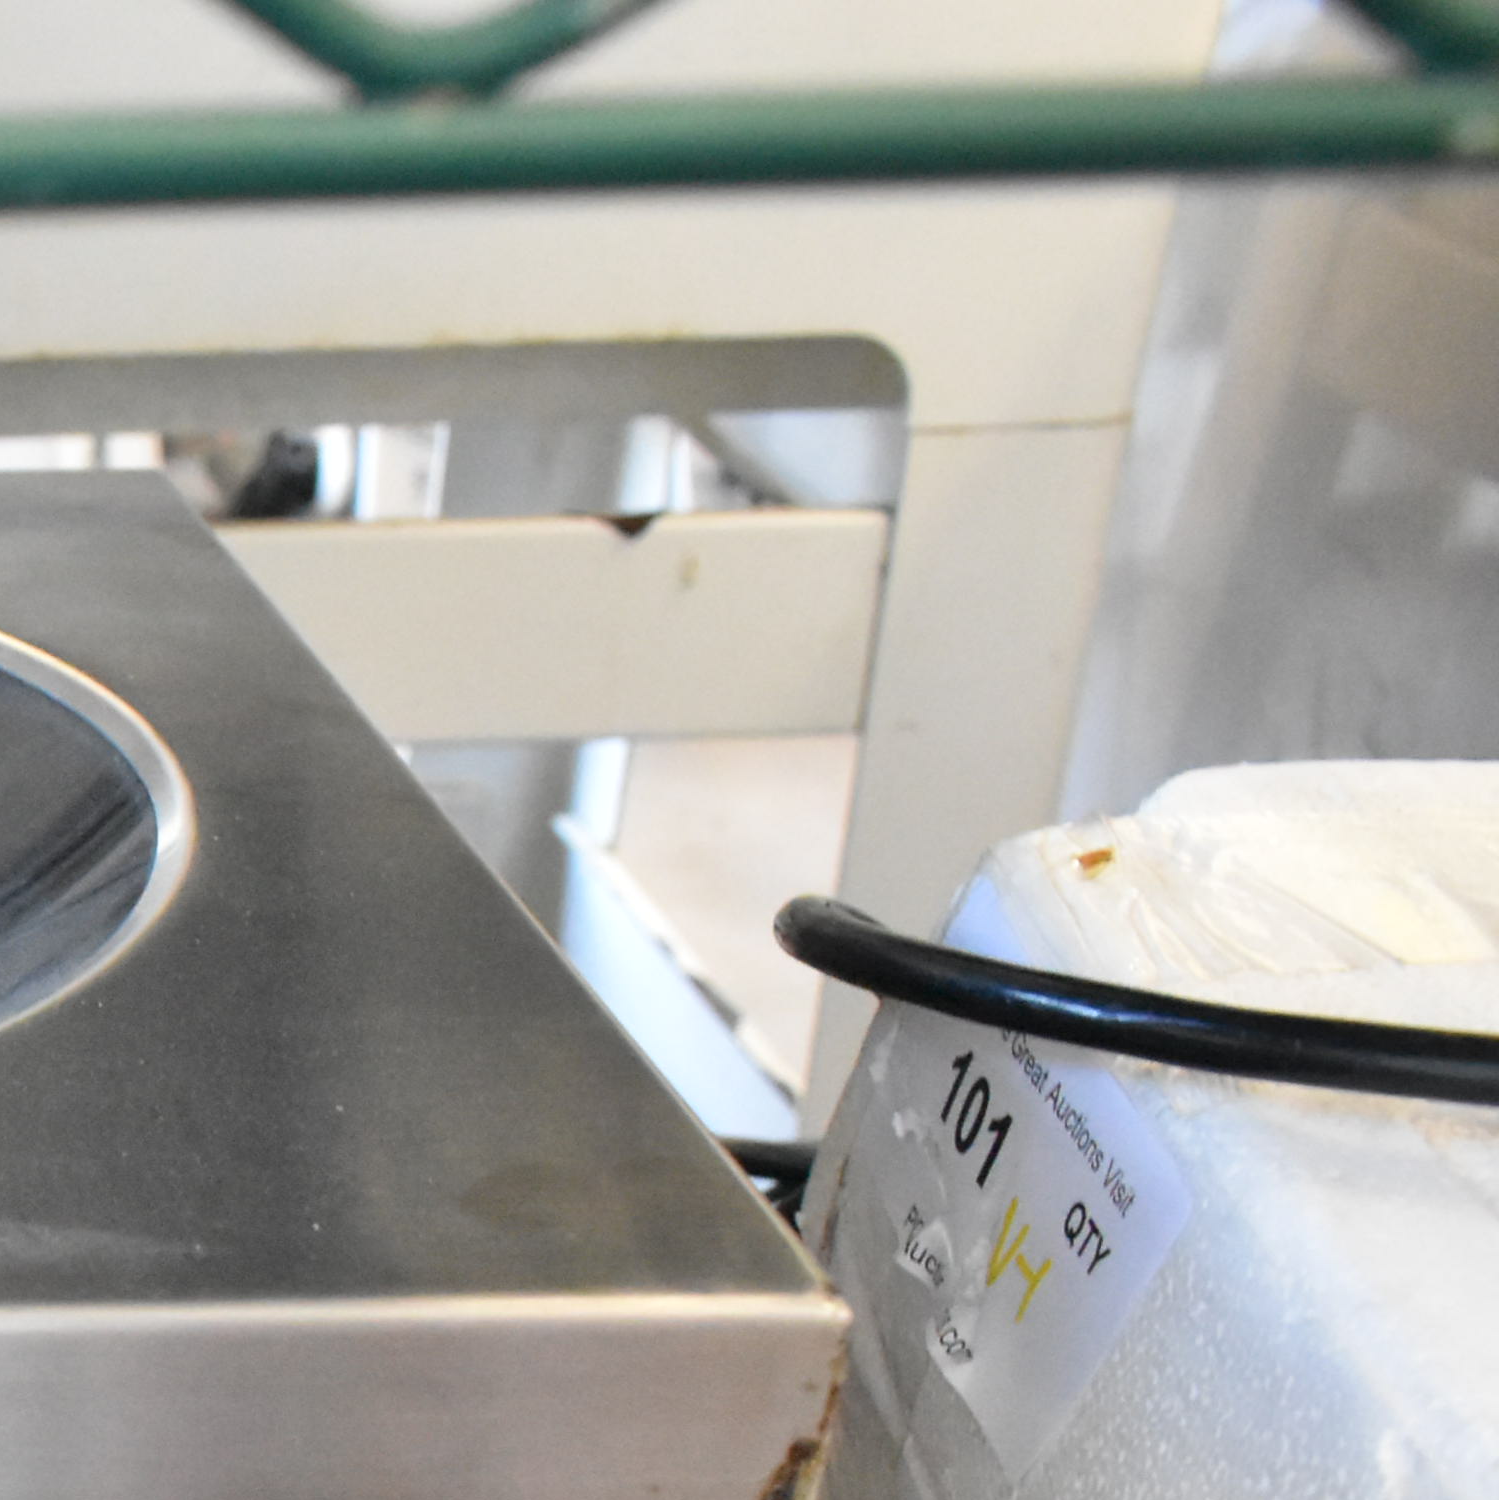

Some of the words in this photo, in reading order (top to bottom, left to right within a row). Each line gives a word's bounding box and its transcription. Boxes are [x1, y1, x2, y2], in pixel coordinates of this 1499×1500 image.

[941, 1050, 1013, 1189] 101
[1045, 1082, 1104, 1172] Auctions
[1103, 1158, 1136, 1218] Visit
[1064, 1202, 1111, 1276] QTY
